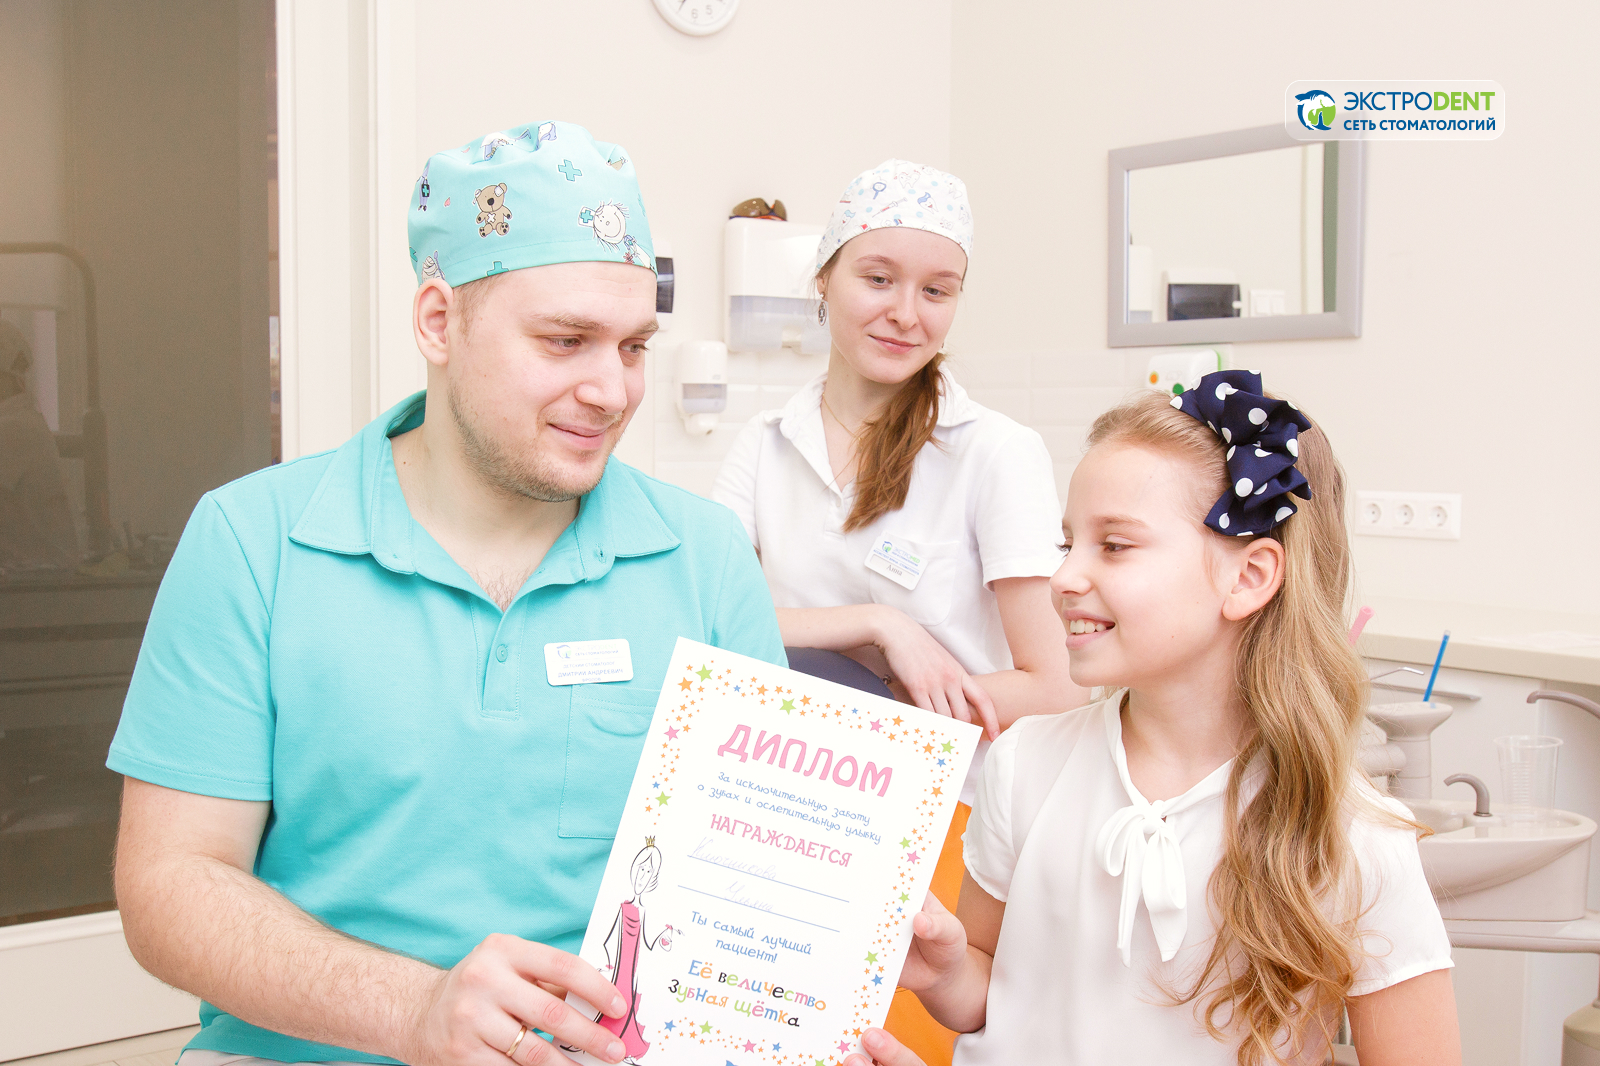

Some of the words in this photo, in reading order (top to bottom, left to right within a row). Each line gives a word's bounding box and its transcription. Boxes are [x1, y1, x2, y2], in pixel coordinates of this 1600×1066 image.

[691, 8, 698, 19] 6
[706, 5, 713, 15] 5
[717, 724, 893, 797] ДИПЛОМ
[718, 771, 731, 783] За
[735, 778, 828, 812] исключительную
[708, 787, 740, 801] зубах
[744, 796, 752, 805] и
[756, 800, 841, 831] ослепительную
[845, 826, 882, 845] улыбку
[710, 813, 853, 868] НАГРАЖДАЕТСЯ
[691, 911, 708, 926] Ты
[713, 920, 755, 939] самый
[761, 934, 812, 955] лучший
[715, 939, 778, 964] пациент!
[688, 959, 713, 979] Её
[718, 972, 827, 1011] величество
[734, 1000, 800, 1028] щётка
